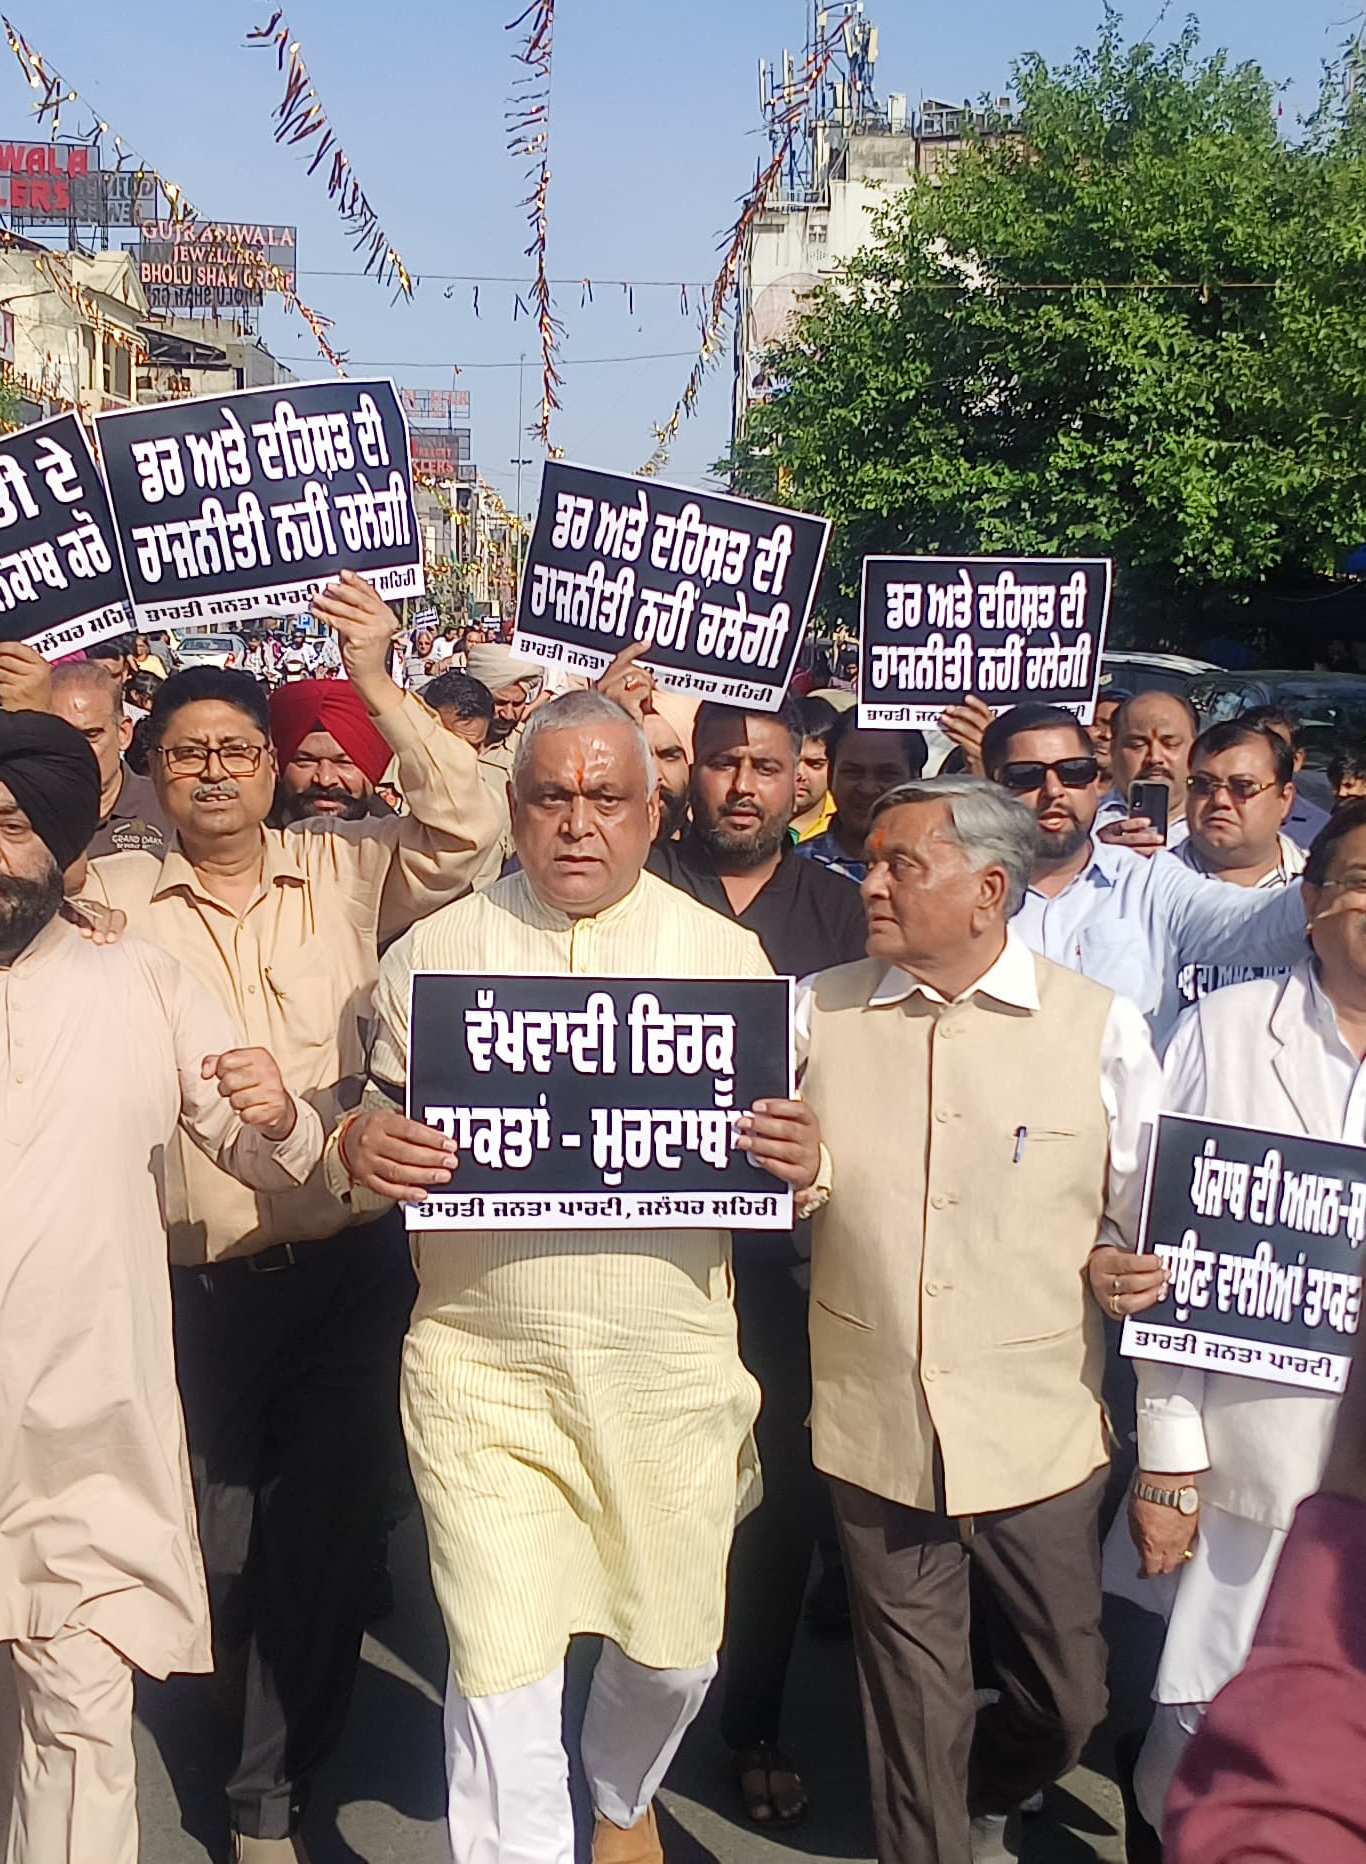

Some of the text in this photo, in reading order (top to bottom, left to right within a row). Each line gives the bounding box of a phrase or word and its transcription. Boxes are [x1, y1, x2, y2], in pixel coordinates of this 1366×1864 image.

[141, 263, 192, 285] BHOLU
[196, 266, 239, 288] SHAH
[33, 437, 84, 503] ਦੇ
[131, 392, 390, 503] ਡਰ ਅਤੇ ਦਹਿਸ਼ਤ ਦੀ
[56, 508, 113, 581] ਕਰੋ
[131, 470, 412, 583] ਰਾਜਨੀਤੀ ਨਹੀਂ ਚਲੇਗੀ
[551, 489, 793, 596] ਡਰ ਅਤੇ ਦਹਿਸ਼ਤ ਦੀ
[145, 600, 204, 622] ਭਾਰਤੀ
[207, 598, 259, 615] ਜਨਤਾ
[531, 560, 791, 669] ਰਾਜਨੀਤੀ ਨਹੀਂ ਚਲੇਗੀ
[886, 568, 1087, 636] ਡਰ ਅਤੇ ਦਹਿਸ਼ਤ ਦੀ
[520, 638, 564, 661] ਭਾਰਤੀ
[567, 649, 606, 670] ਜਨਤਾ
[871, 631, 1092, 691] ਰਾਜਨੀਤੀ ਨਹੀਂ ਚਲੇਗੀ
[866, 707, 910, 722] ਭਾਰਤੀ
[463, 988, 736, 1107] ਵੱਖਵਾਦੀ ਫਿਰਕੂ
[591, 1106, 757, 1186] ਮੁਰਦਾਬਾ
[418, 1195, 778, 1220] ਭਾਰਤੀ ਜਨਤਾ ਪਾਰਟੀ, ਜਲੰਧਰ ਸ਼ਹਿਰੀ
[1190, 1138, 1250, 1221] ਪੰਜਾਬ
[1249, 1149, 1283, 1226] ਦੀ
[1216, 1241, 1308, 1324] ਵਾਲੀਆਂ
[1303, 1267, 1364, 1334] ਤਾਕਤ
[1134, 1328, 1341, 1383] ਭਾਰਤੀ ਜਨਤਾ ਪਾਰਟੀ,
